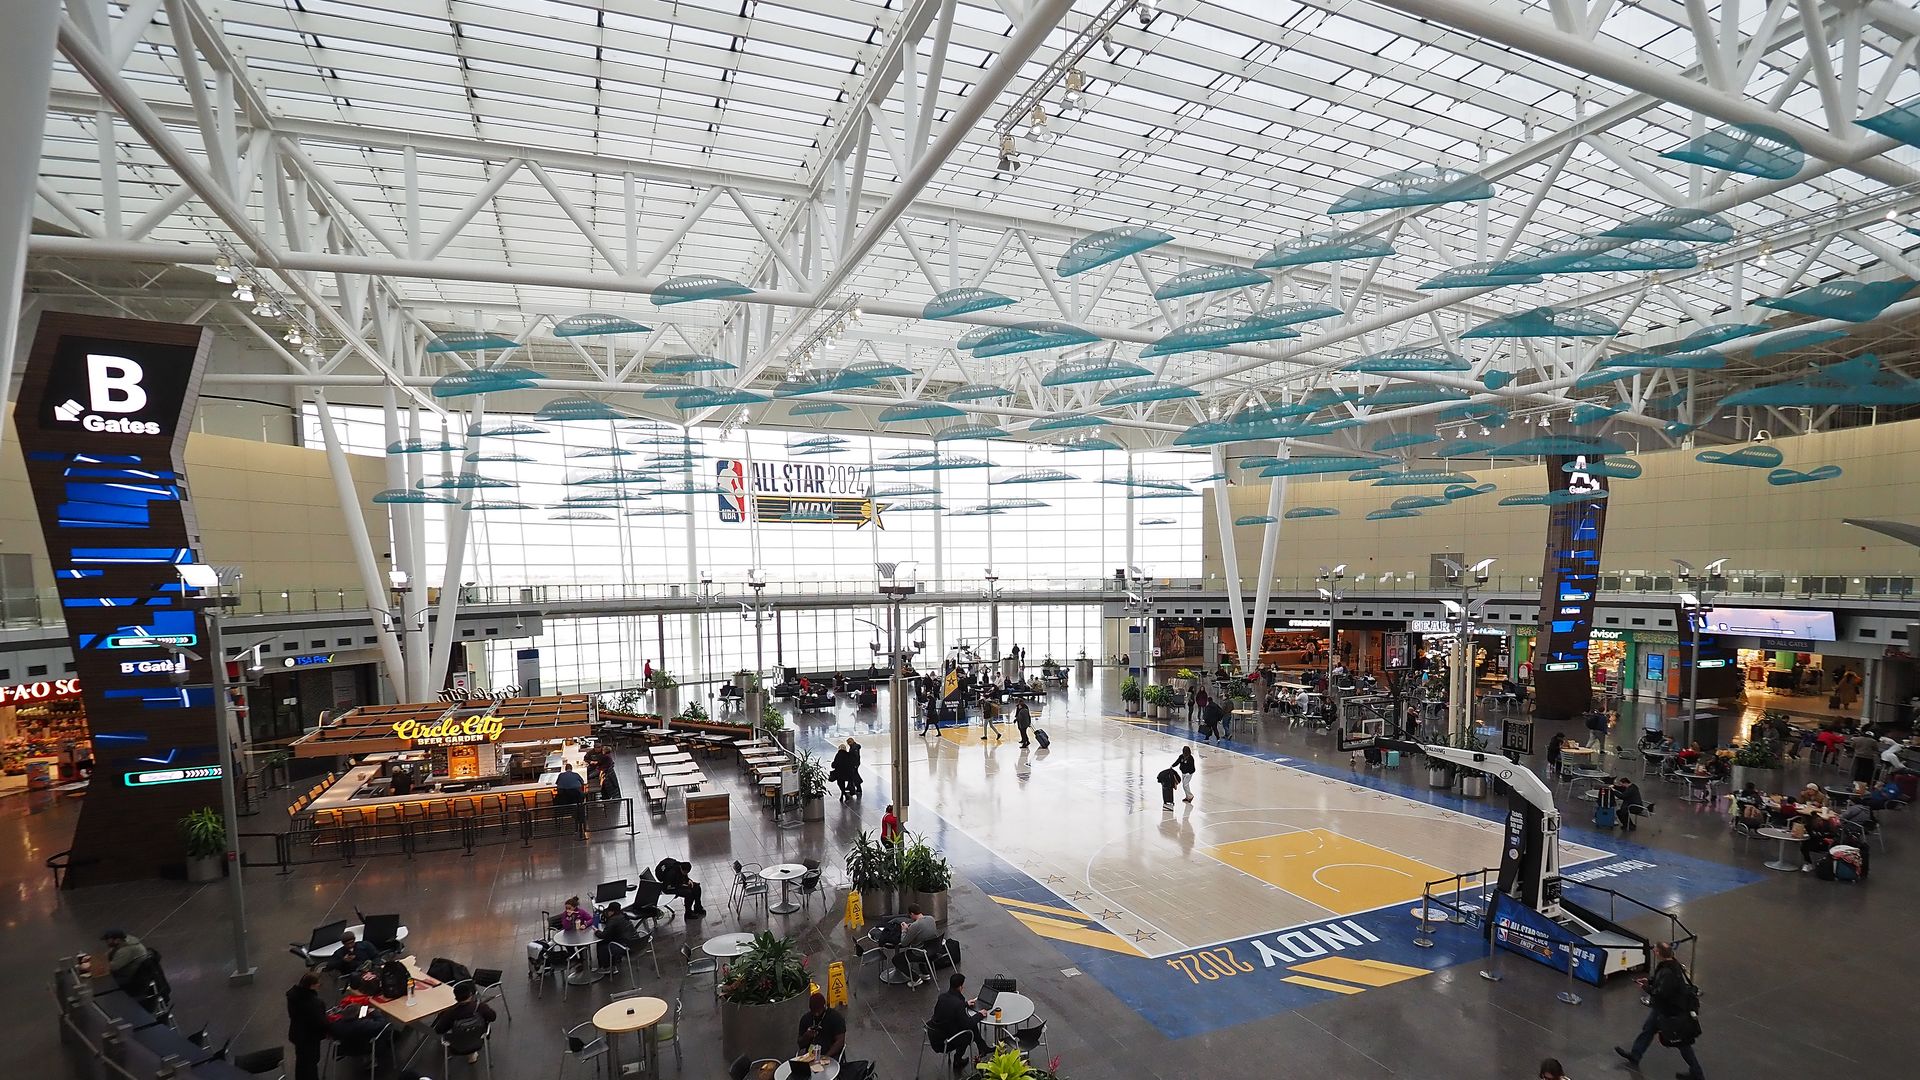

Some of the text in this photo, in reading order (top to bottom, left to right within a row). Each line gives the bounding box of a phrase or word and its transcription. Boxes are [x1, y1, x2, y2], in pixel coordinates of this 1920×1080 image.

[86, 353, 148, 414] B
[83, 412, 161, 435] Gates
[752, 462, 866, 495] ALL STAR 2024
[721, 508, 737, 520] NBA
[1412, 620, 1450, 632] GEAR
[296, 656, 312, 665] TSA
[120, 662, 135, 673] B
[392, 715, 506, 741] Circle City
[417, 736, 443, 746] BEER
[445, 734, 484, 745] GARDEN
[1520, 939, 1536, 950] INDY
[1166, 919, 1382, 985] INDY 2024
